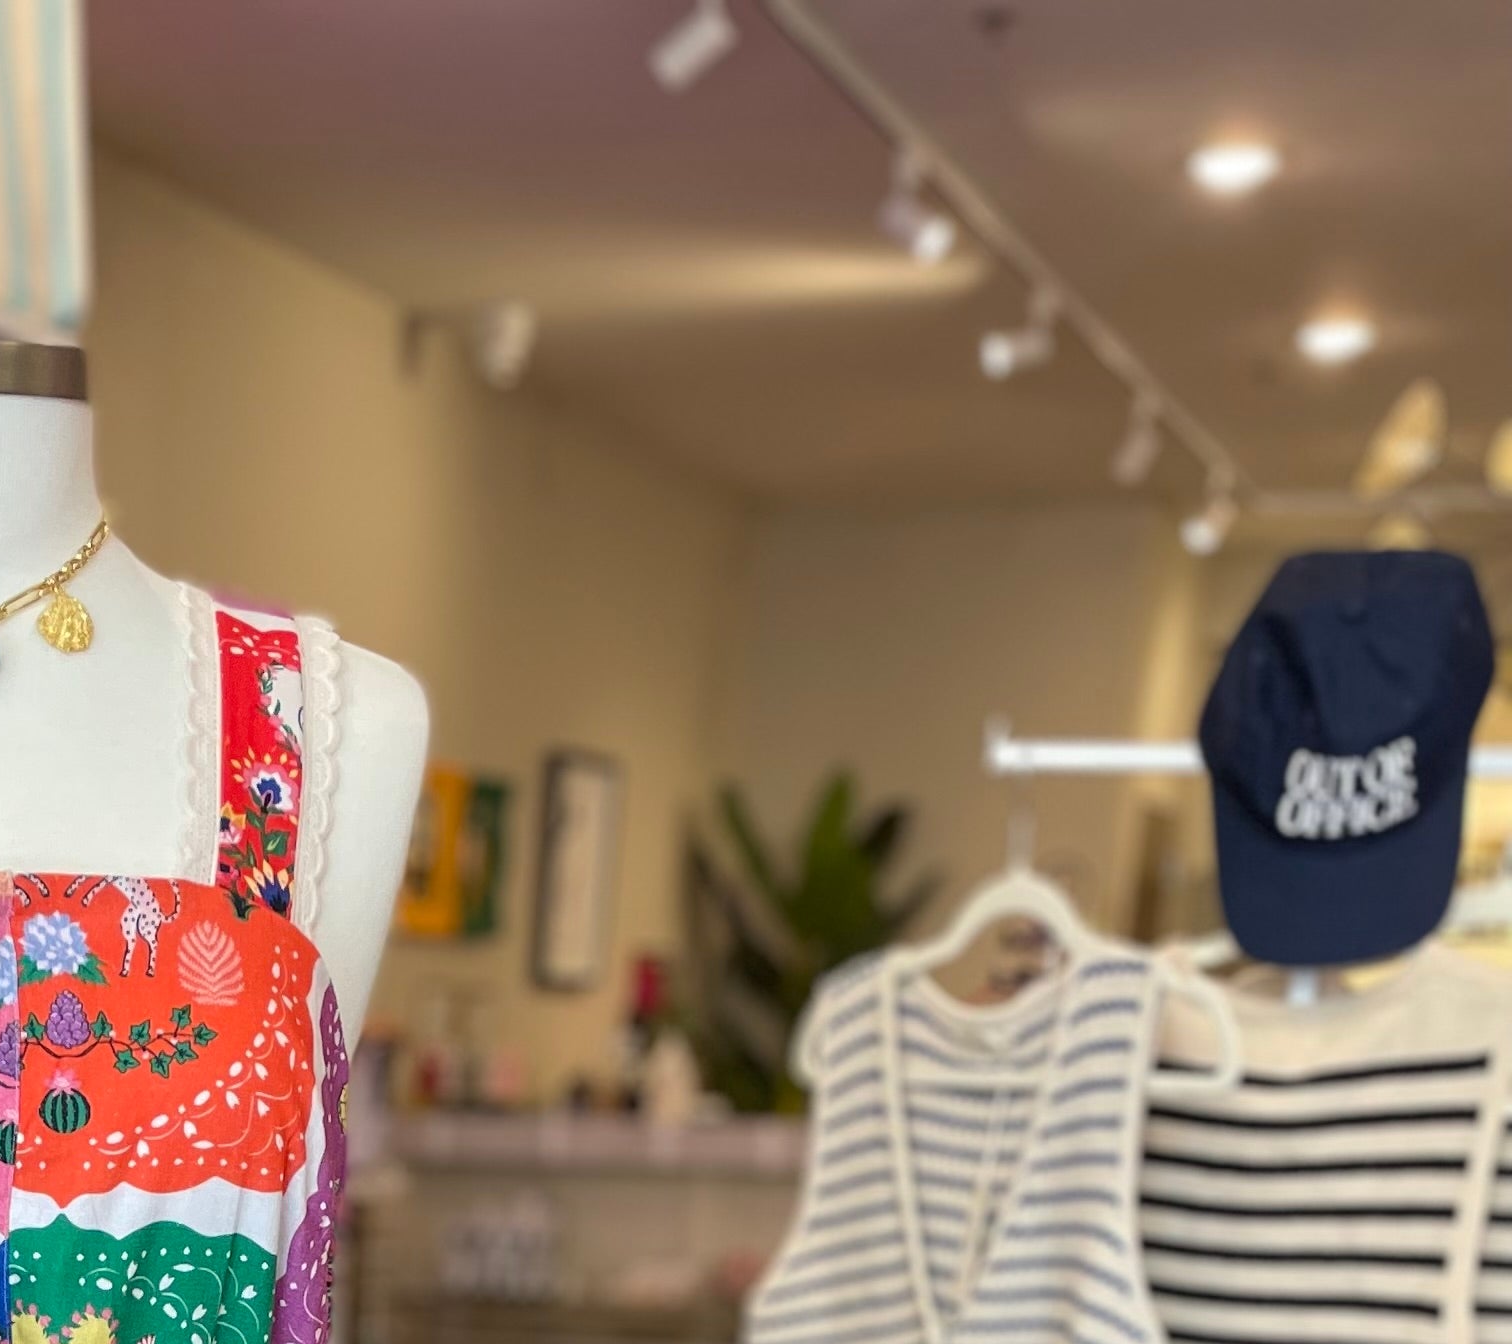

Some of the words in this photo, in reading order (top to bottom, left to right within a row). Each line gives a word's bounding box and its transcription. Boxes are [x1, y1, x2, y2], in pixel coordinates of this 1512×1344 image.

[1285, 748, 1364, 801] OUT
[1361, 735, 1417, 795] OF
[1275, 777, 1419, 839] OFFICE
